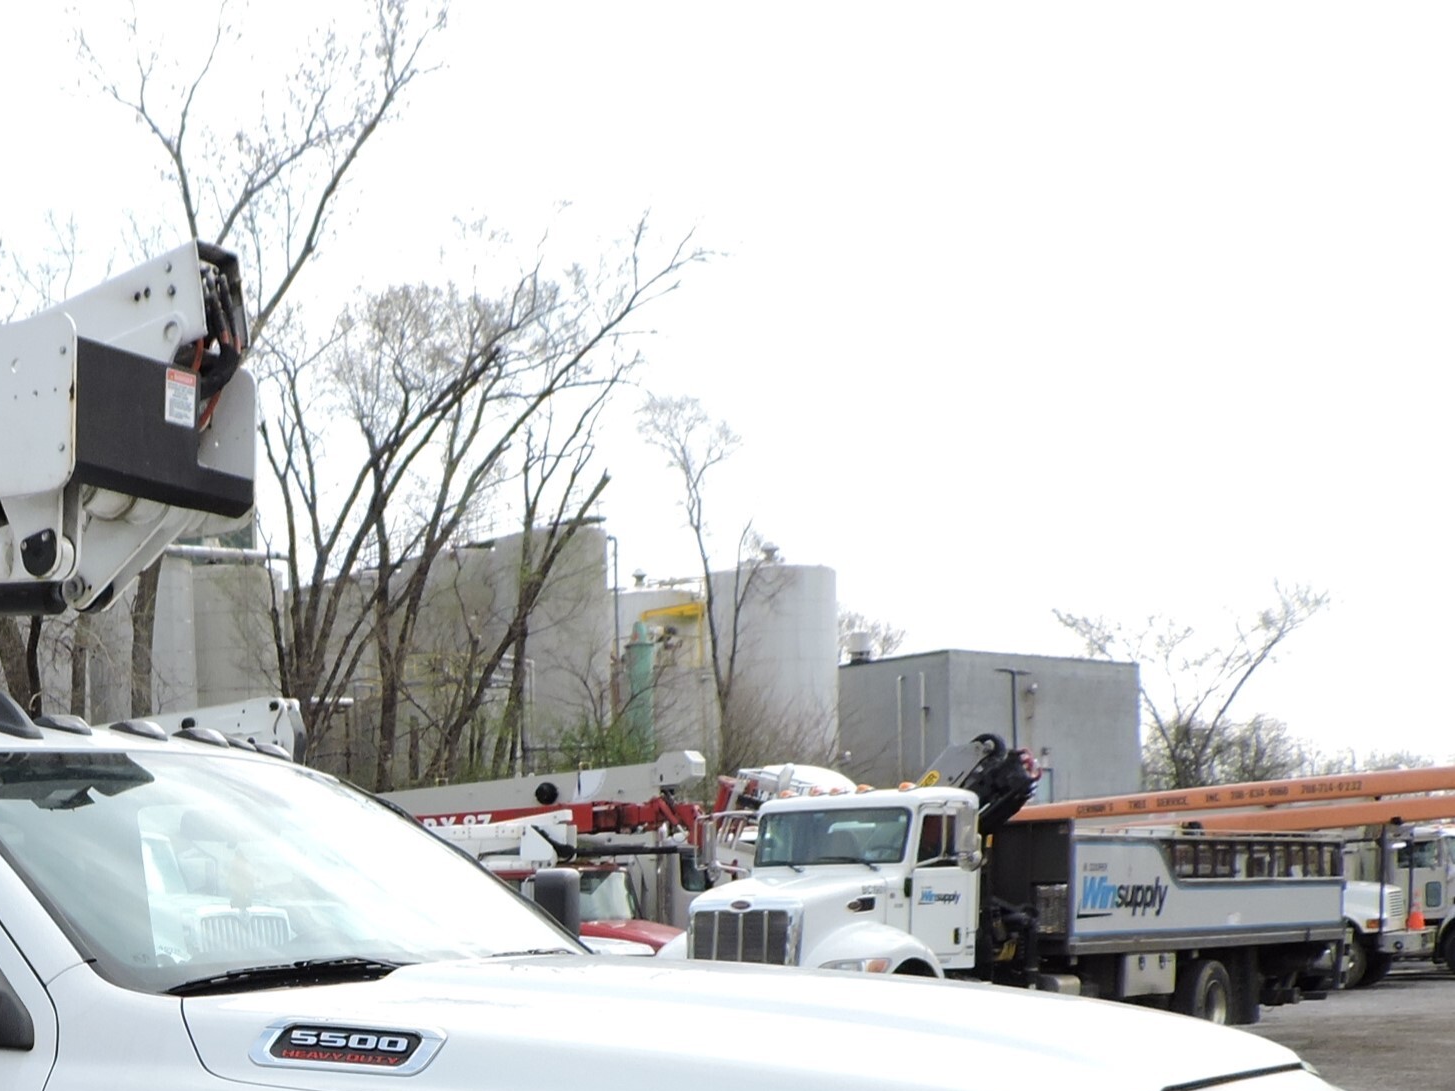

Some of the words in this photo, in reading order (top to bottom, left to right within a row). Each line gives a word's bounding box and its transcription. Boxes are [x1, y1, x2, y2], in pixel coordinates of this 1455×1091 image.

[1080, 875, 1168, 917] Winsupply
[290, 1030, 409, 1052] 5500
[282, 1049, 344, 1060] HEAVY
[346, 1054, 400, 1065] DUTY
